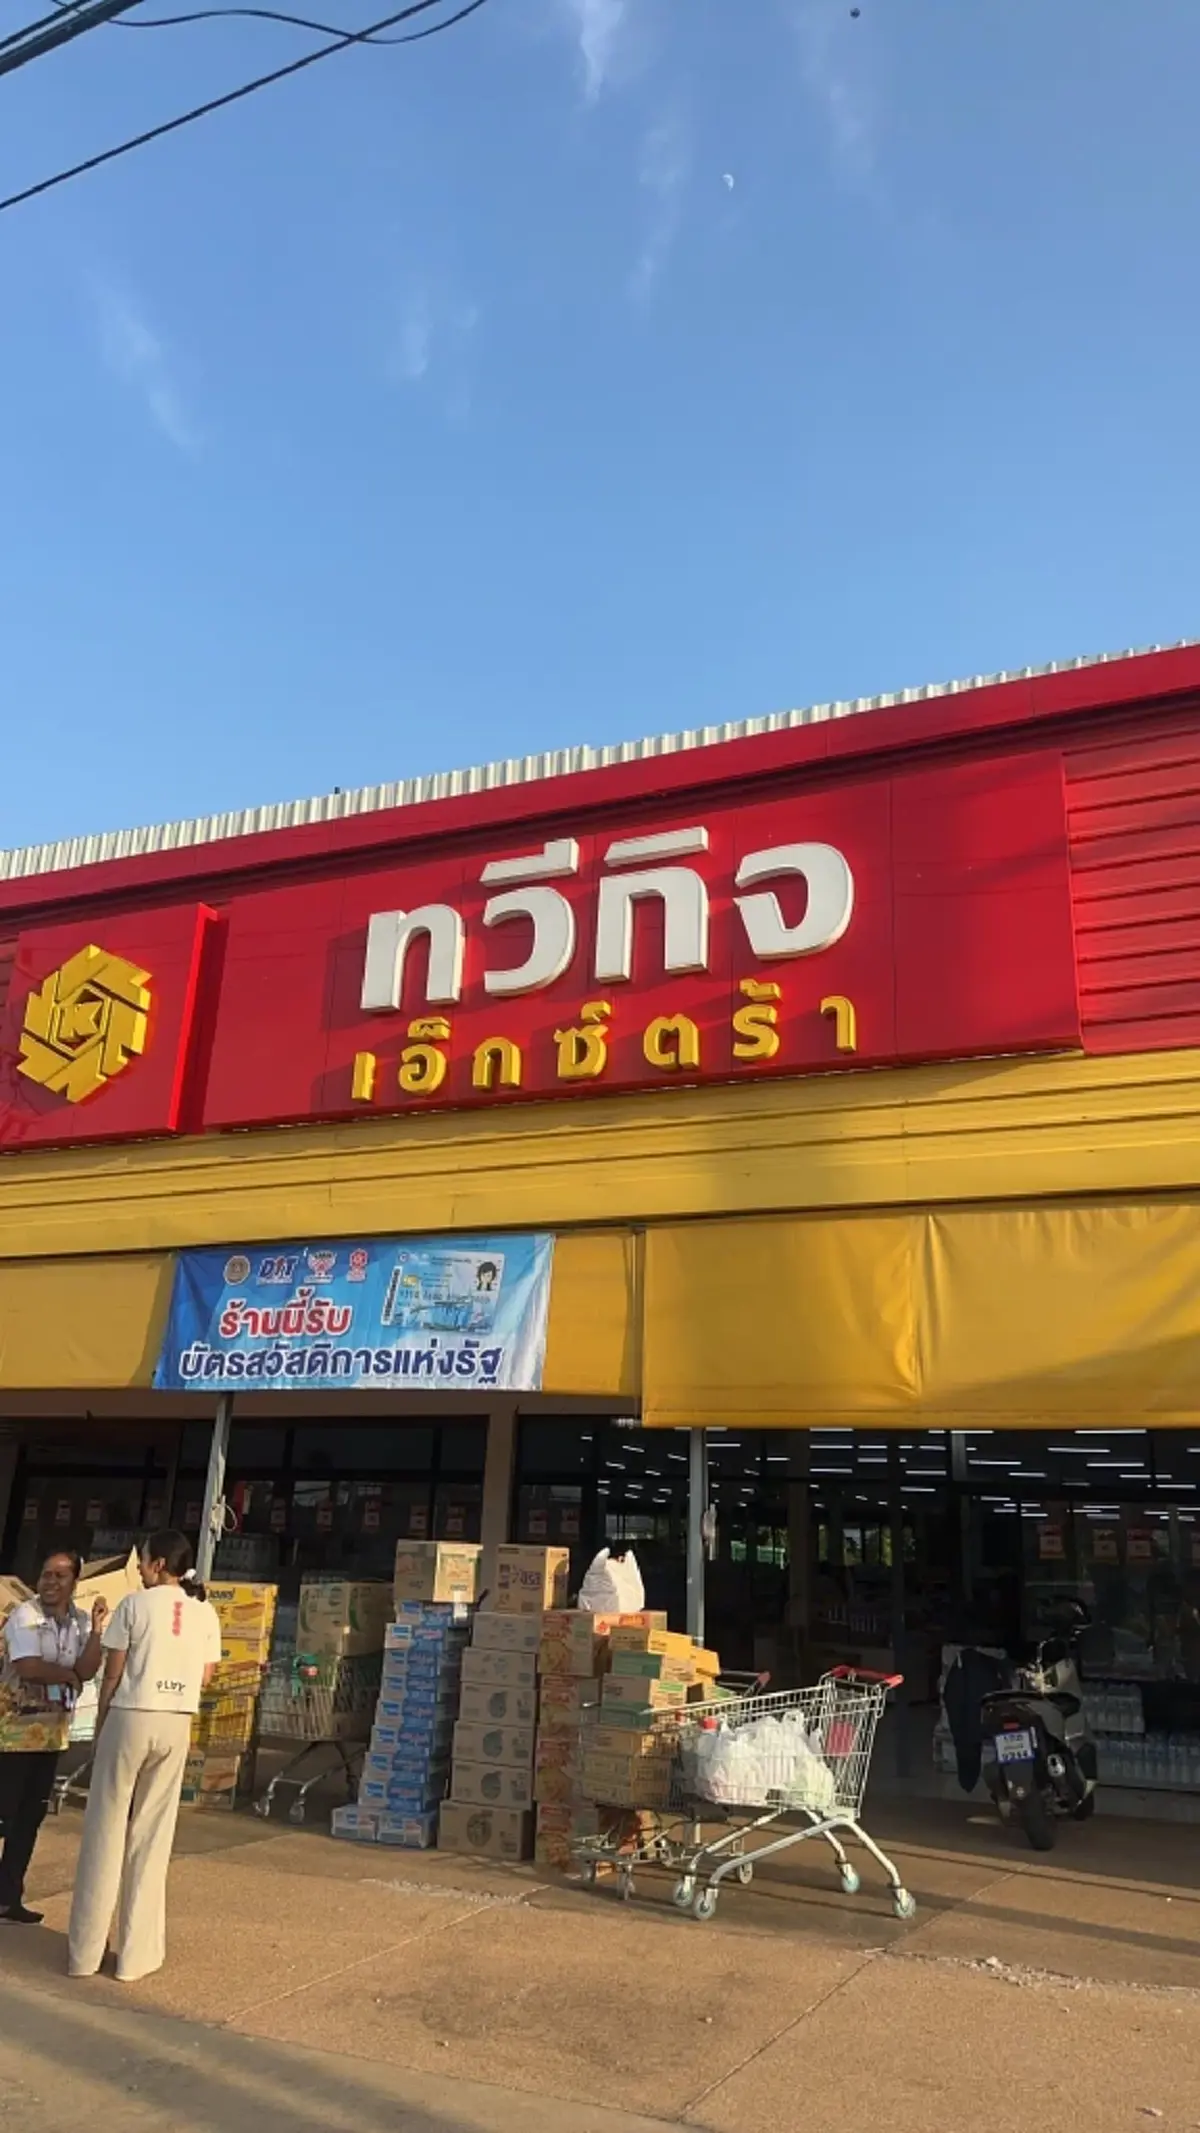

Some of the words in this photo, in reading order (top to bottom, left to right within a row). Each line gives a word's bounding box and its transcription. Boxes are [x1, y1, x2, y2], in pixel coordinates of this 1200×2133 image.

[361, 826, 855, 1012] ทวีกิจ
[351, 979, 858, 1102] เอ็กซ์ตร้า
[220, 1288, 351, 1337] ร้านนี้รับ
[180, 1338, 502, 1384] บัตรสวัสดิการแห่งรัฐ
